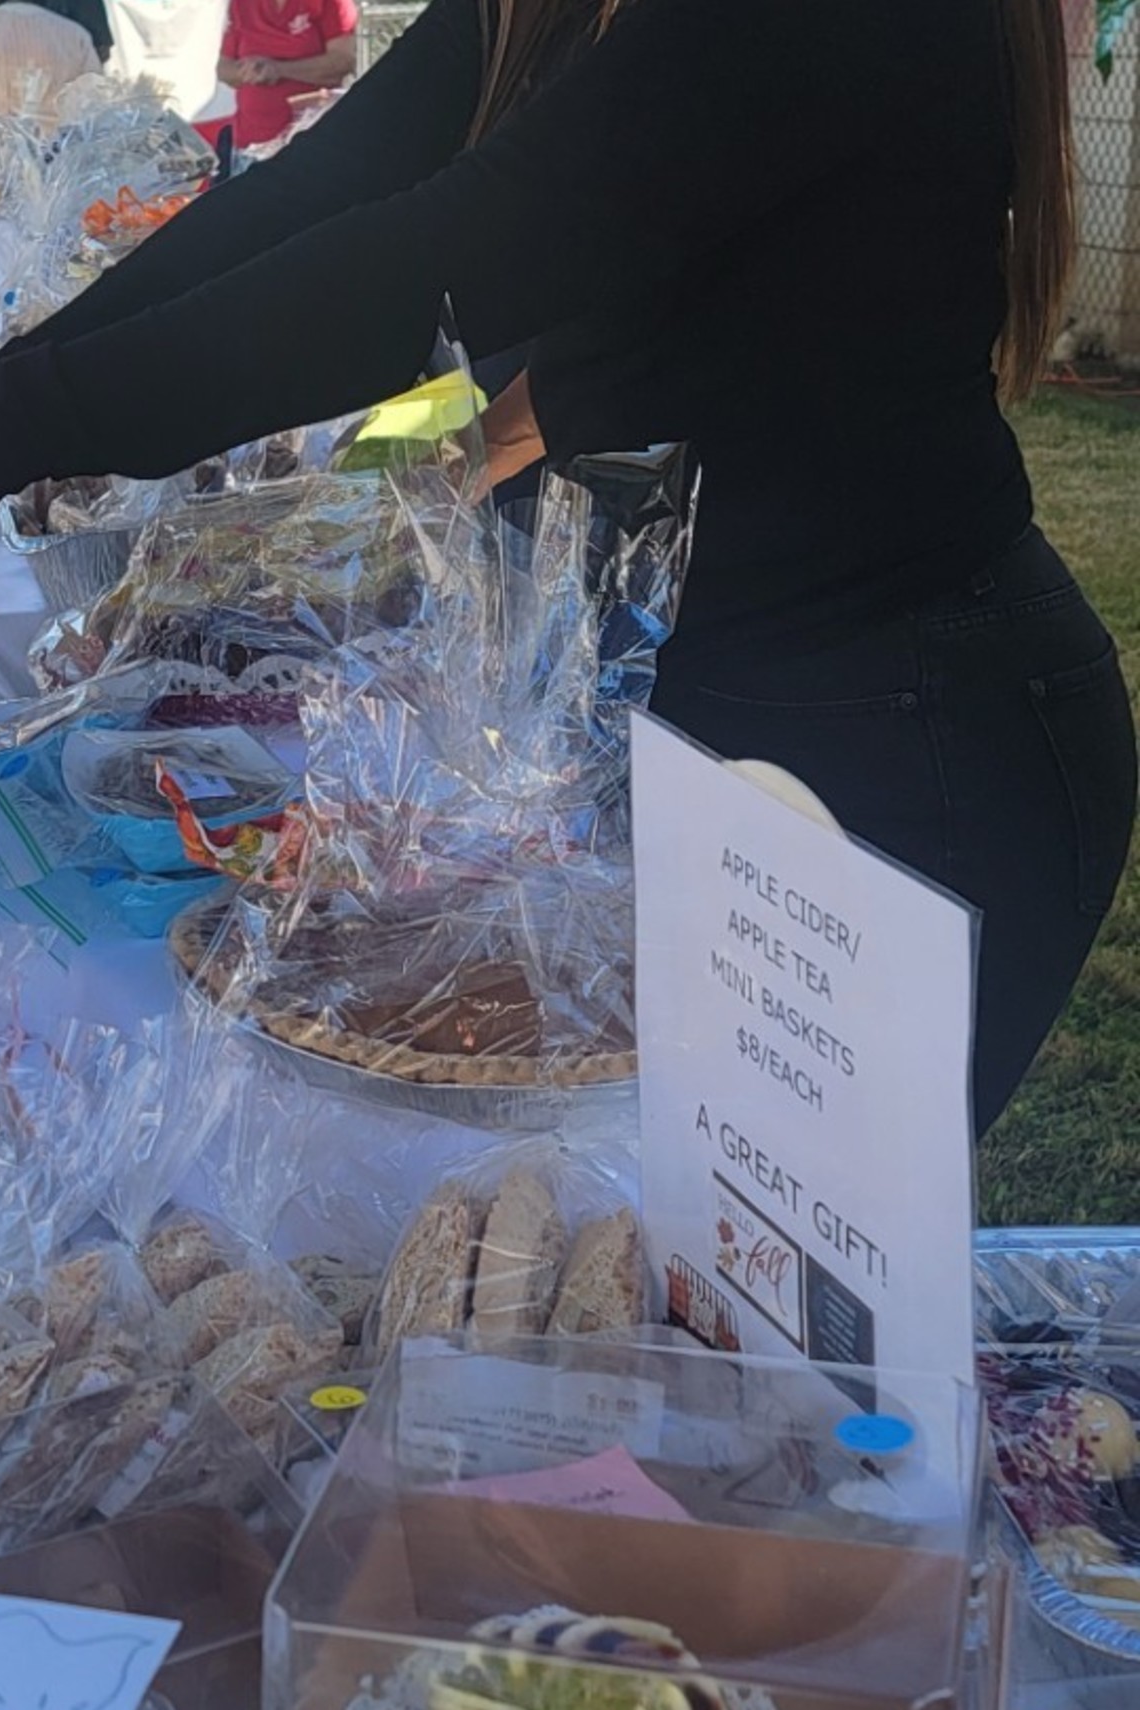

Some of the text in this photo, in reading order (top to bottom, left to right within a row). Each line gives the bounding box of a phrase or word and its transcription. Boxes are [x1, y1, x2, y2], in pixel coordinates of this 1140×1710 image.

[721, 846, 861, 963] APPLE CIDER/
[727, 908, 832, 1005] APPLE TEA
[710, 949, 855, 1077] MINI BASKETS
[736, 1025, 823, 1113] $8/EACH
[696, 1103, 888, 1289] A GREAT GIFT!
[717, 1190, 756, 1239] HELLO
[742, 1235, 793, 1318] fall
